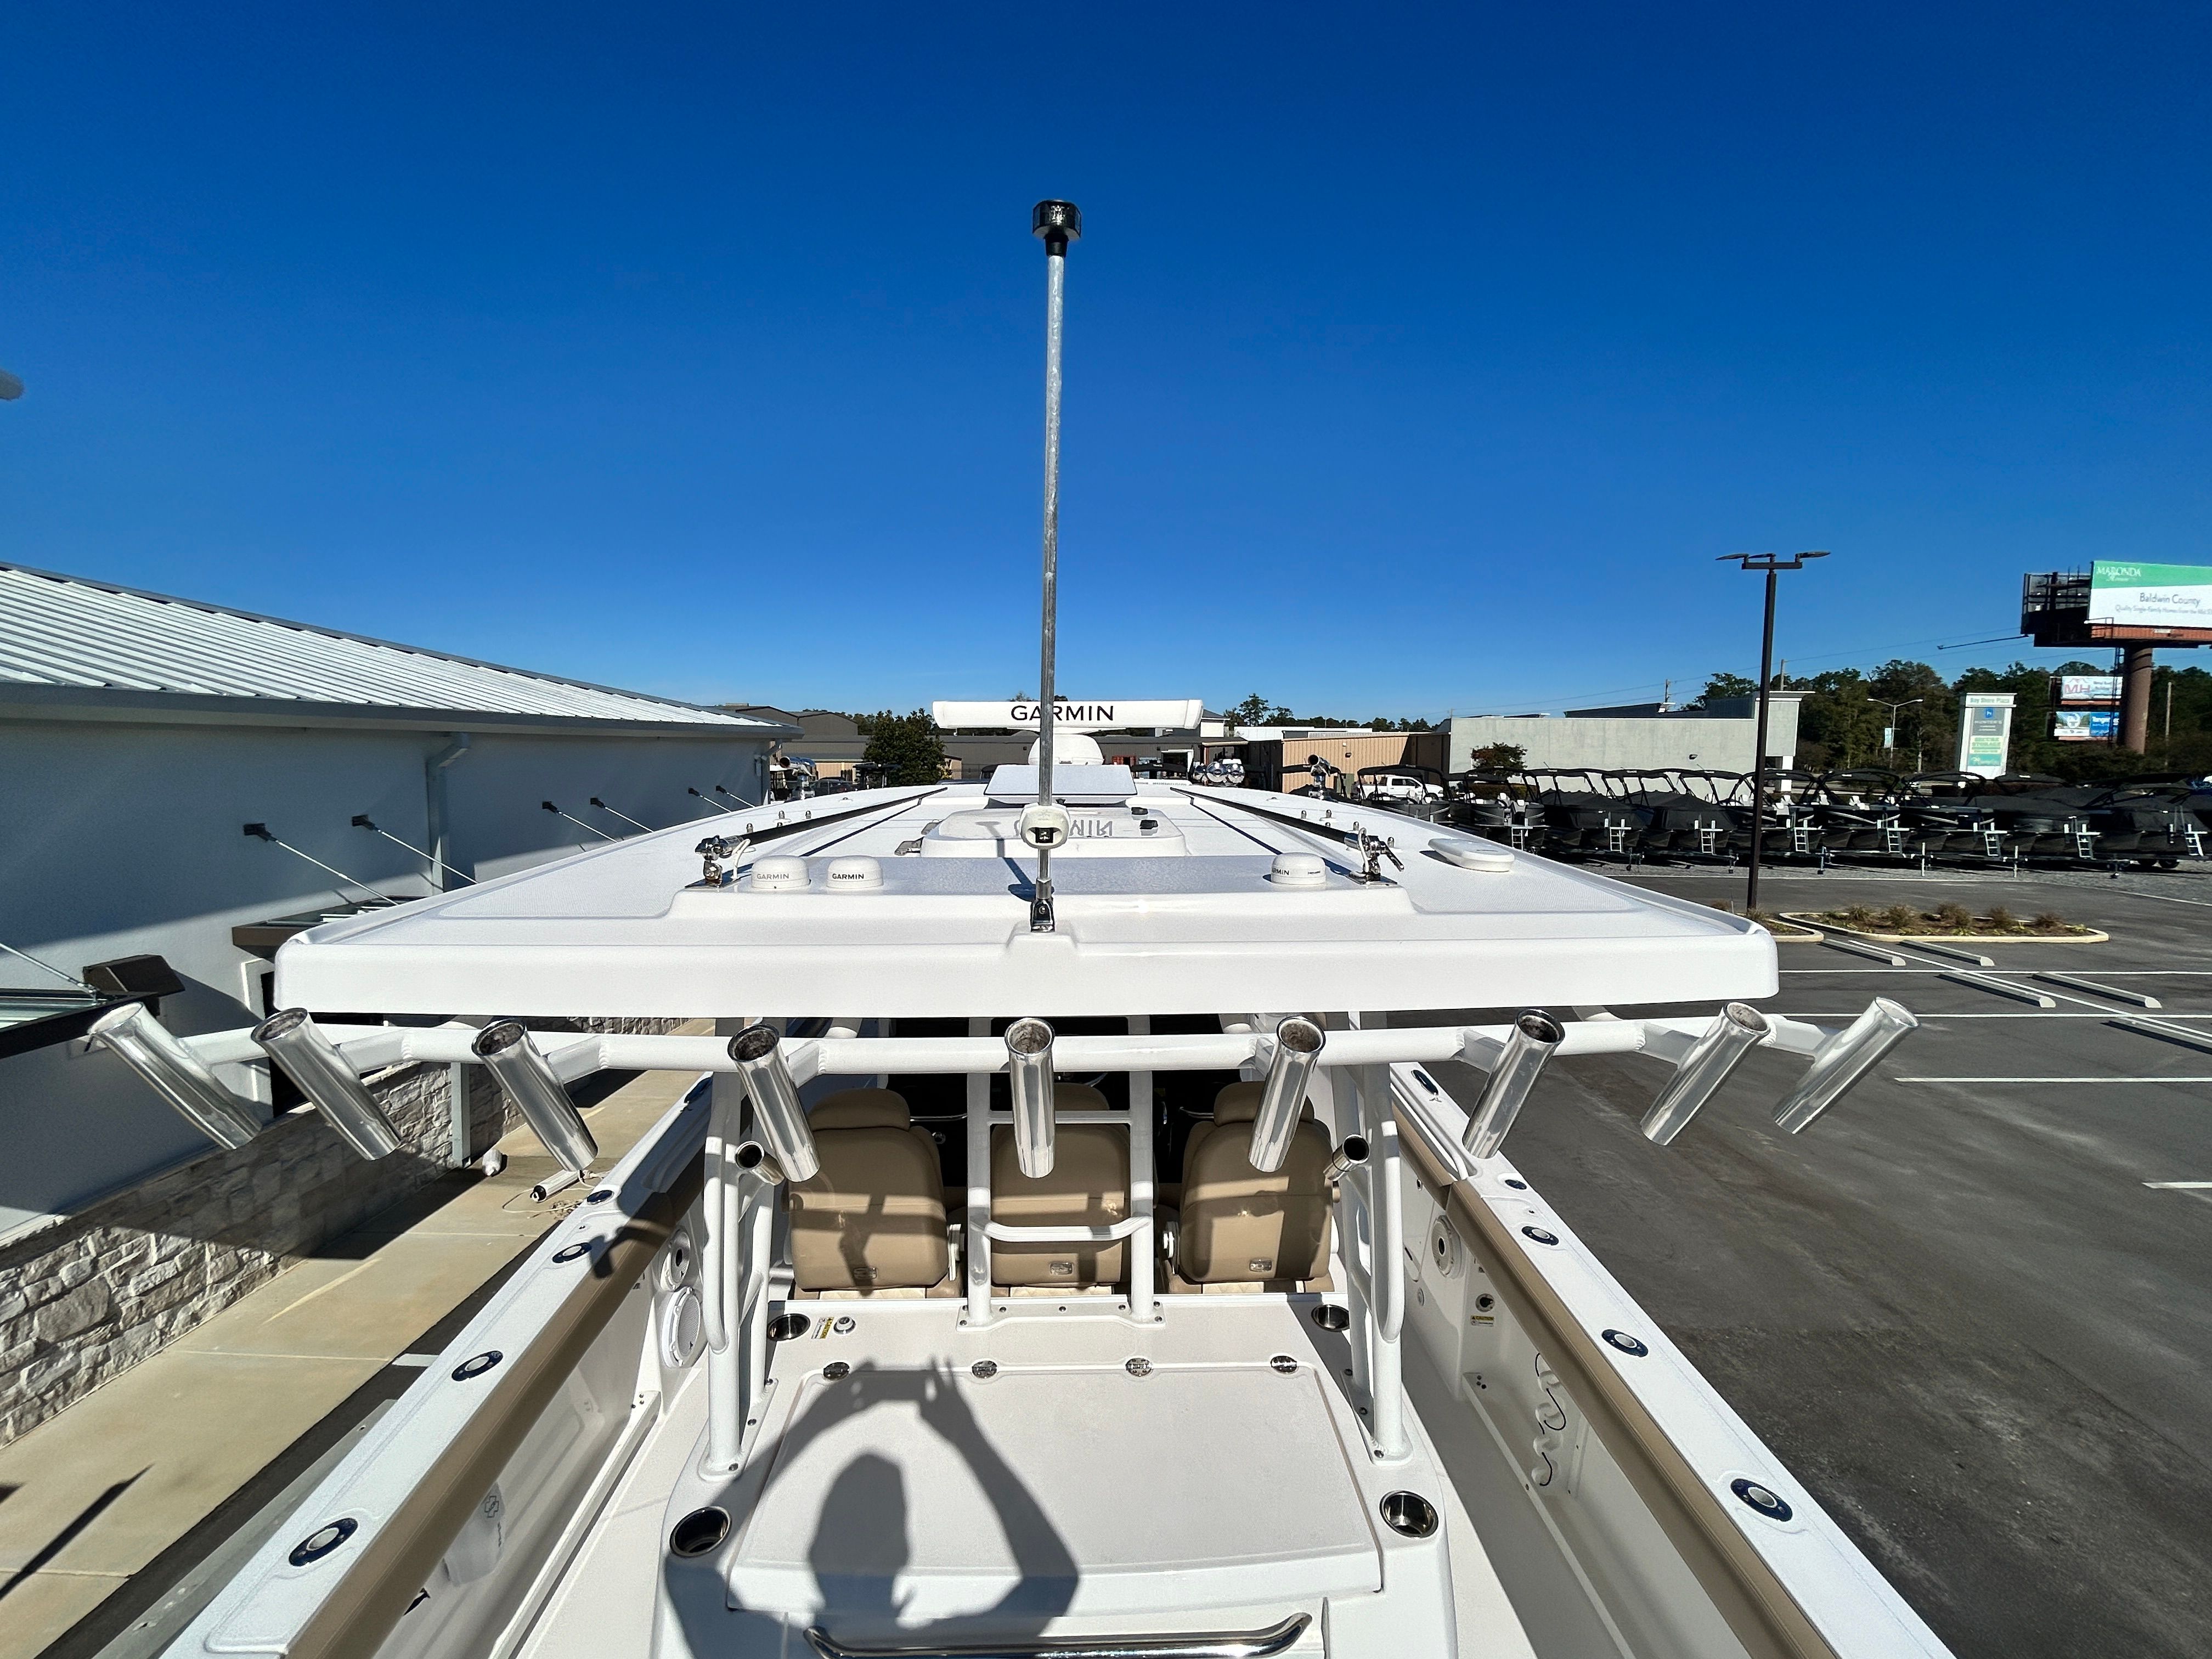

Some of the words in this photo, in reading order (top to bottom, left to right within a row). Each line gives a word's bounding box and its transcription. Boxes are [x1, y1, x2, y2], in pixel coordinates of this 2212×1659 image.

[2096, 567, 2141, 576] MARONDA
[2140, 592, 2170, 602] Baldwin
[2171, 594, 2201, 608] County
[2064, 684, 2091, 694] MH
[1011, 705, 1114, 721] GARMIN
